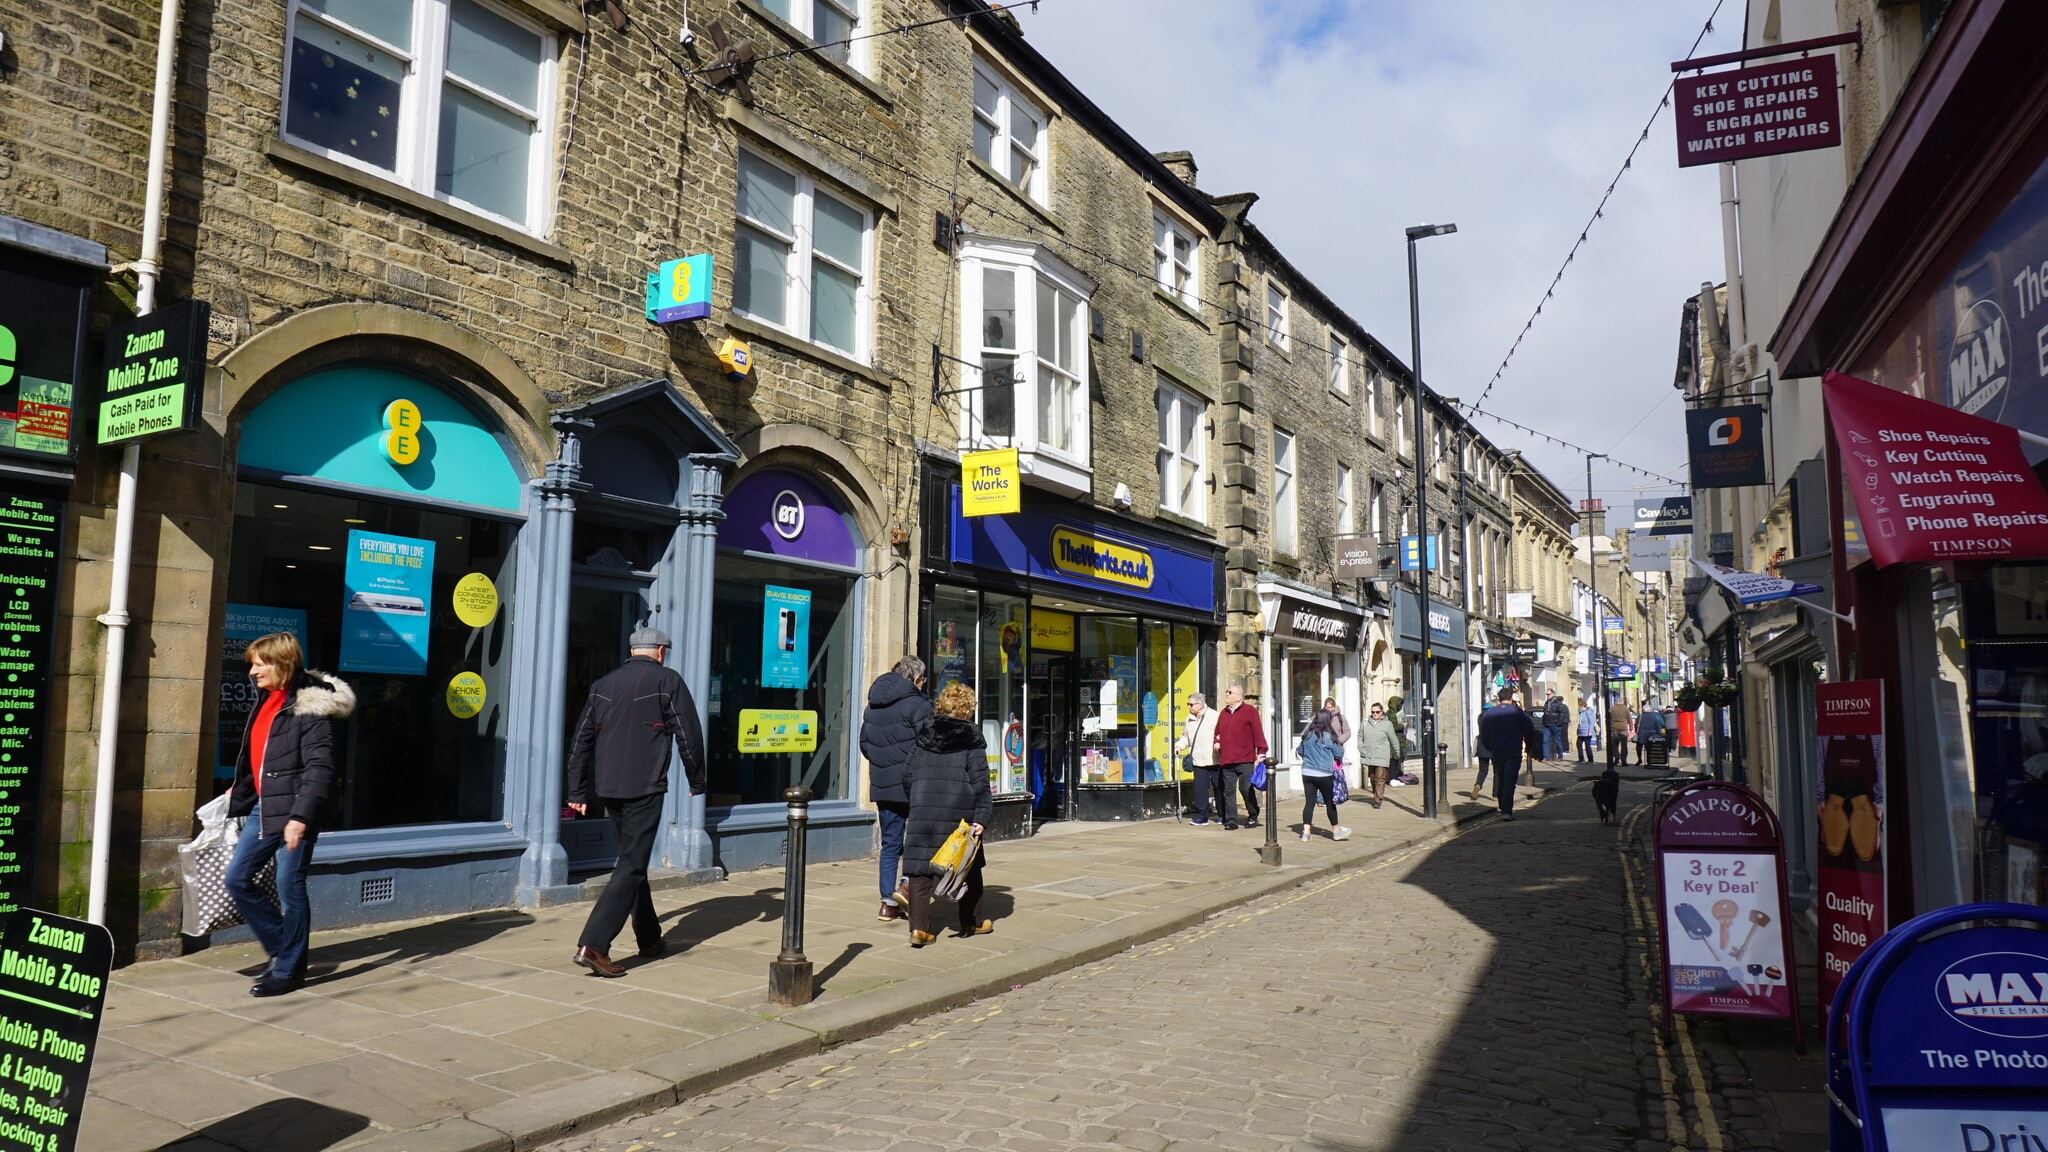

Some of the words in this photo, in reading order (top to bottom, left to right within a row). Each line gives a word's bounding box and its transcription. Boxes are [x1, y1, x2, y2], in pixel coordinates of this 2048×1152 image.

[1696, 83, 1729, 99] KEY
[1737, 69, 1812, 92] CUTTING
[1693, 100, 1736, 116] SHOE
[1744, 87, 1819, 108] REPAIRS
[1707, 107, 1807, 132] ENGRAVING
[1688, 134, 1746, 152] WATCH
[1754, 121, 1829, 142] REPAIRS
[125, 330, 164, 358] Zaman
[735, 349, 747, 364] ADT
[1951, 316, 2006, 407] MAX
[107, 362, 145, 392] Mobile
[148, 357, 178, 382] Zone
[22, 403, 67, 419] Alarm
[111, 401, 132, 417] Cash
[135, 395, 155, 412] Paid
[158, 393, 171, 406] for
[107, 421, 135, 438] Mobile
[139, 415, 172, 431] Phones
[1878, 430, 1923, 443] Shoe
[1926, 430, 1991, 445] Repairs
[1884, 450, 1918, 465] Key
[1924, 449, 1988, 465] Cutting
[980, 465, 1001, 477] The
[1891, 470, 1952, 485] Watch
[1956, 469, 2024, 484] Repairs
[972, 478, 1008, 491] Works
[11, 497, 43, 509] Zaman
[1899, 491, 1996, 509] Engraving
[32, 512, 55, 522] Zone
[778, 504, 798, 525] BT
[1638, 505, 1688, 518] Cawley's
[1906, 516, 1968, 531] Phone
[1973, 511, 2048, 529] Repairs
[8, 534, 22, 543] We
[1930, 538, 2012, 552] TIMPSON
[45, 549, 54, 558] in
[360, 538, 396, 553] EVERYTHING
[398, 544, 409, 555] YOU
[410, 546, 424, 557] LOVE
[360, 550, 392, 564] INCLUDING
[394, 554, 405, 566] THE
[406, 557, 422, 568] PRICE
[1058, 538, 1148, 580] TheWorks.co.uk
[1340, 557, 1373, 566] express
[457, 591, 496, 600] CONSOLES
[767, 590, 786, 599] SAVE
[1739, 586, 1783, 595] PHOTOS
[9, 600, 29, 610] LCD
[4, 612, 32, 621] (Screen)
[246, 616, 271, 624] STORE
[272, 617, 298, 626] ABOUT
[1293, 608, 1319, 635] vision
[0, 622, 40, 632] roblems
[237, 623, 256, 631] NEW
[0, 647, 31, 657] Water
[0, 662, 34, 672] amage
[220, 703, 228, 712] A
[1825, 698, 1871, 711] TIMPSON
[0, 726, 30, 735] eaker
[2, 739, 24, 748] Mic.
[1669, 798, 1762, 827] TIMPSON
[1689, 860, 1702, 876] 3
[1706, 863, 1728, 877] for
[1732, 860, 1746, 876] 2
[1684, 880, 1714, 895] Key
[1825, 892, 1874, 921] Quality
[28, 917, 85, 954] Zaman
[1832, 923, 1867, 947] Shoe
[1, 949, 56, 986] Mobile
[58, 963, 100, 998] Zone
[1674, 969, 1723, 978] SECURITY
[1674, 976, 1701, 985] KEYS
[40, 1028, 86, 1063] Phone
[1920, 1050, 1969, 1068] The
[1975, 1050, 2048, 1068] Photo
[1, 1054, 12, 1078] &
[14, 1057, 63, 1098] Laptop
[23, 1096, 68, 1126] Repair
[47, 1133, 58, 1152] &
